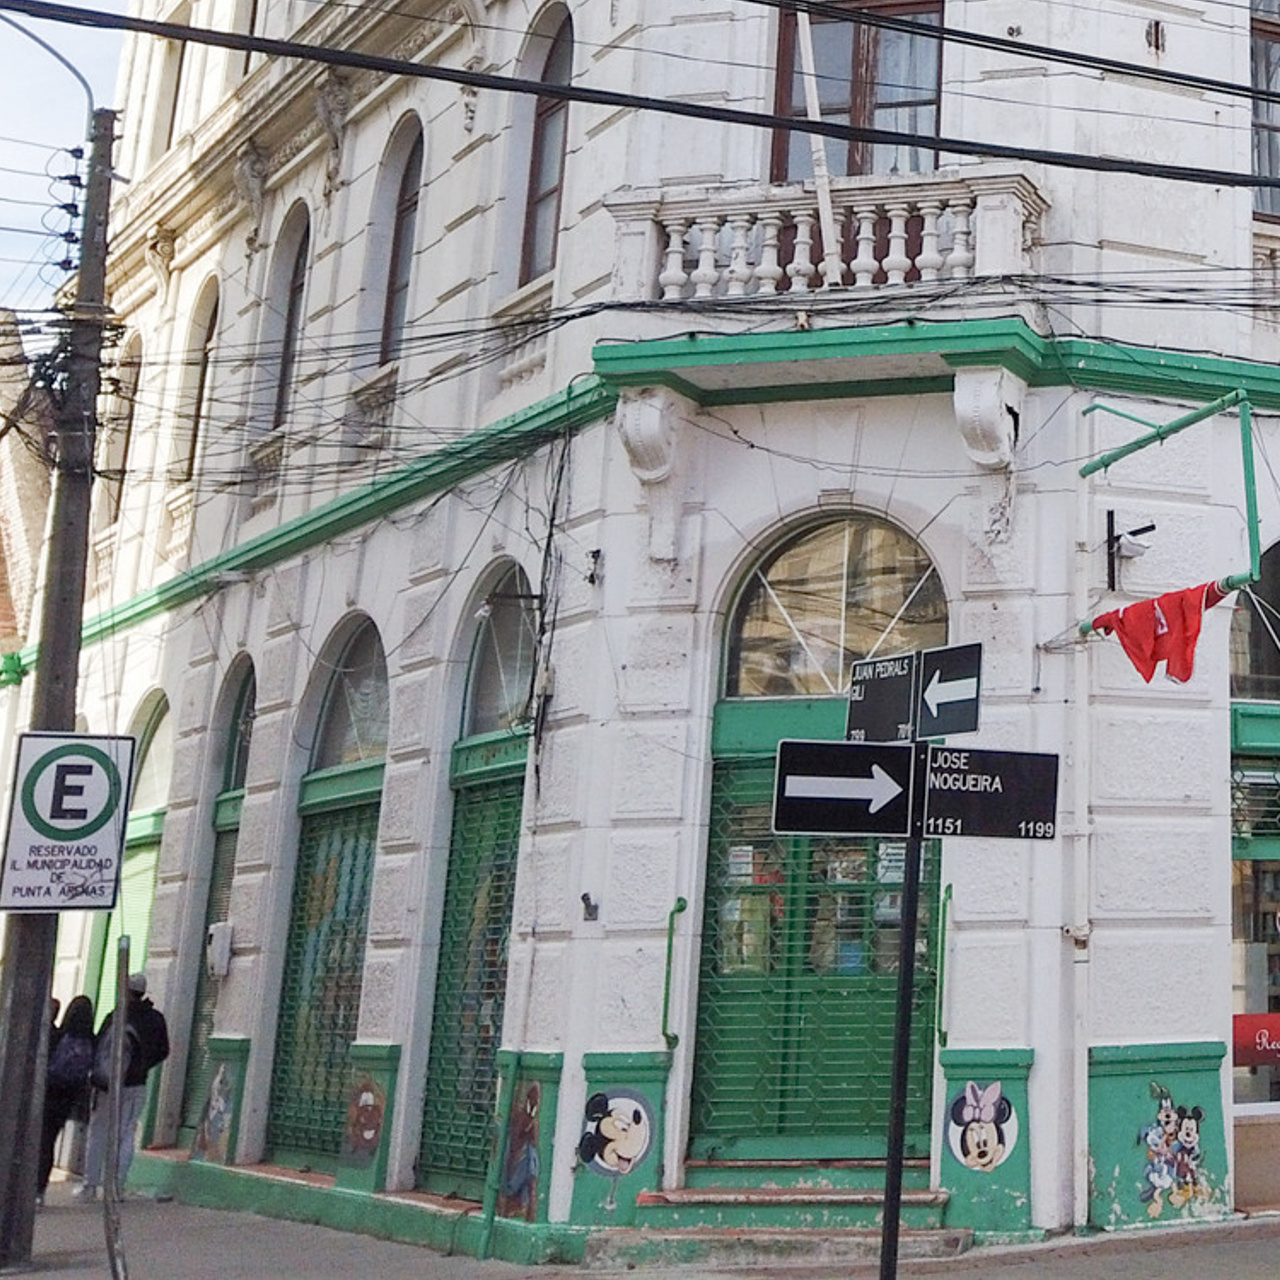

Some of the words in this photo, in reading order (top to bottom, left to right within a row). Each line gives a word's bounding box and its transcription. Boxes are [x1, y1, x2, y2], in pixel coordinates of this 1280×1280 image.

[852, 664, 874, 681] JUAN
[875, 659, 909, 679] PEDRALS
[931, 751, 970, 770] JOSE
[929, 771, 1003, 793] NOGUEIRA
[49, 764, 94, 821] E
[927, 818, 962, 834] 1151
[1018, 821, 1054, 838] 1199
[28, 845, 98, 857] RESERVADO
[26, 858, 113, 871] MUNICIPALIDAD
[50, 872, 66, 884] DE
[11, 885, 52, 898] PUNTA
[58, 885, 106, 898] ARENAS
